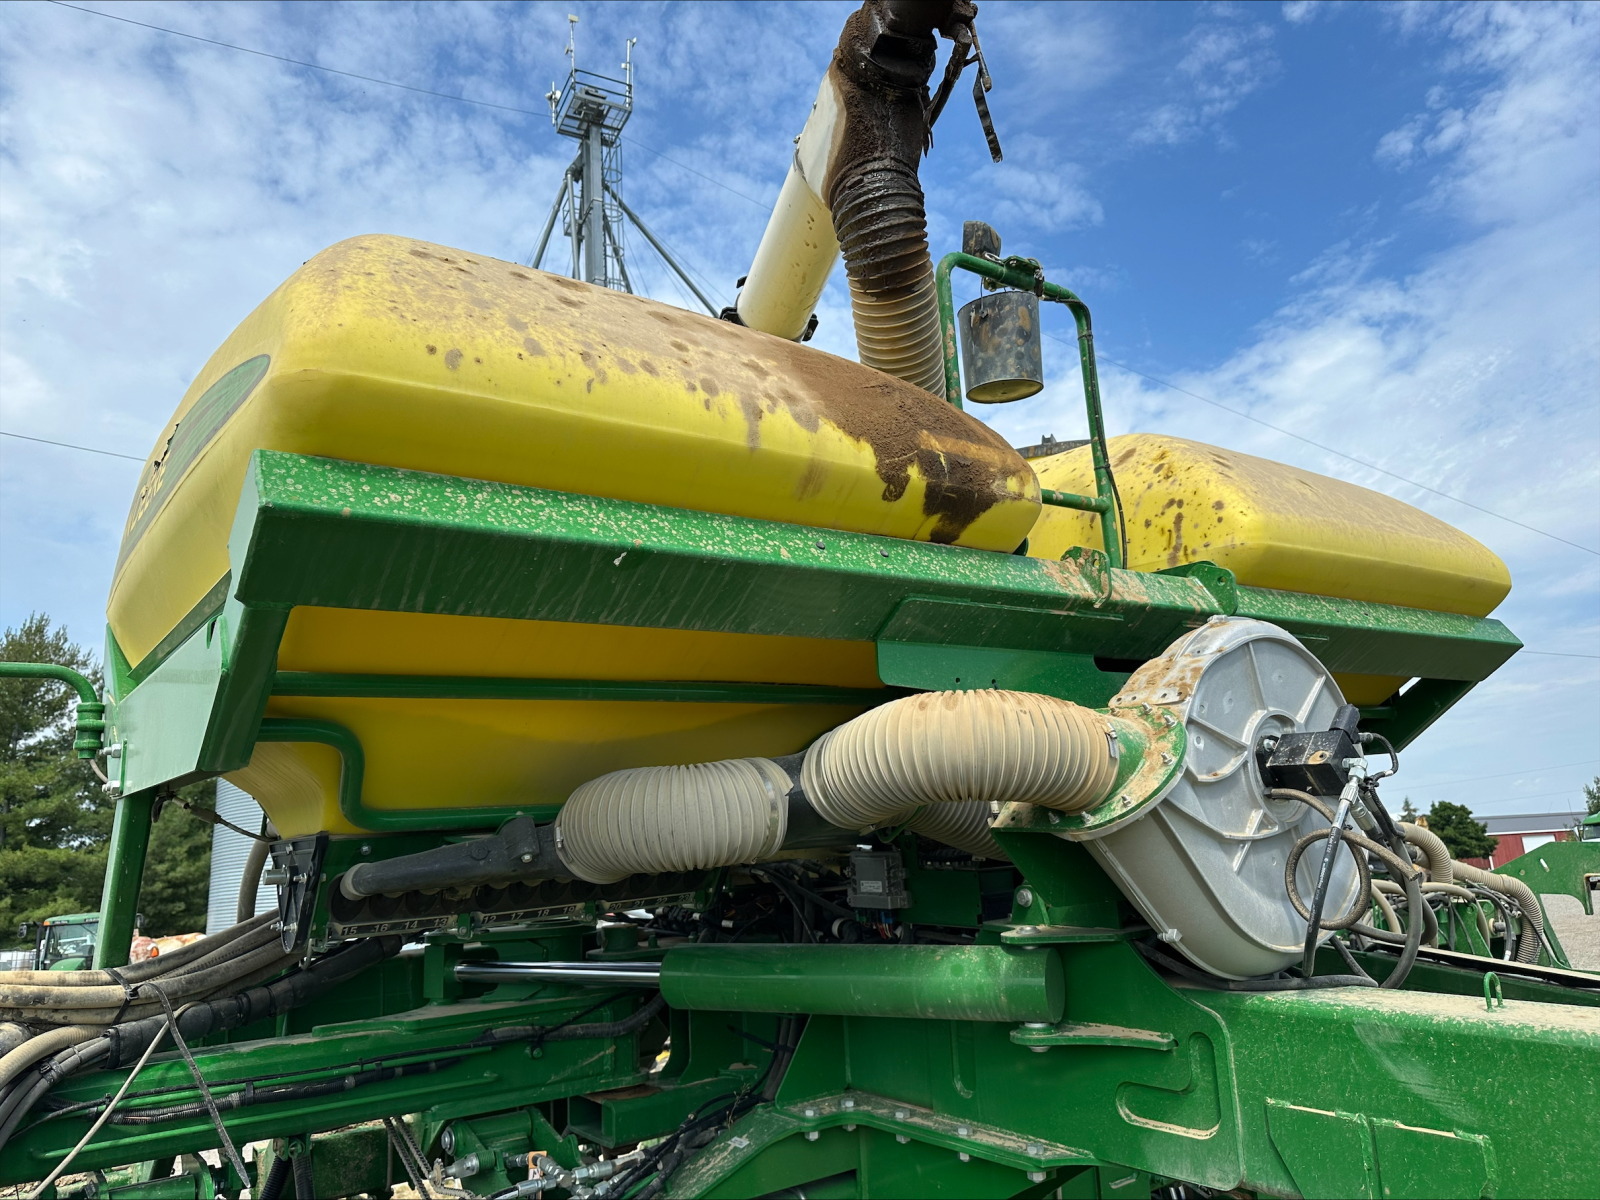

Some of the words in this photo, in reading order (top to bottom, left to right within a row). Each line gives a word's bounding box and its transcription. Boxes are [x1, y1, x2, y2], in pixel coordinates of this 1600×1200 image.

[483, 916, 497, 924] 12
[511, 912, 524, 920] 17
[538, 909, 550, 917] 18
[563, 906, 575, 914] 19
[343, 927, 358, 935] 15
[374, 924, 388, 932] 16
[404, 921, 418, 929] 14
[433, 919, 447, 927] 13
